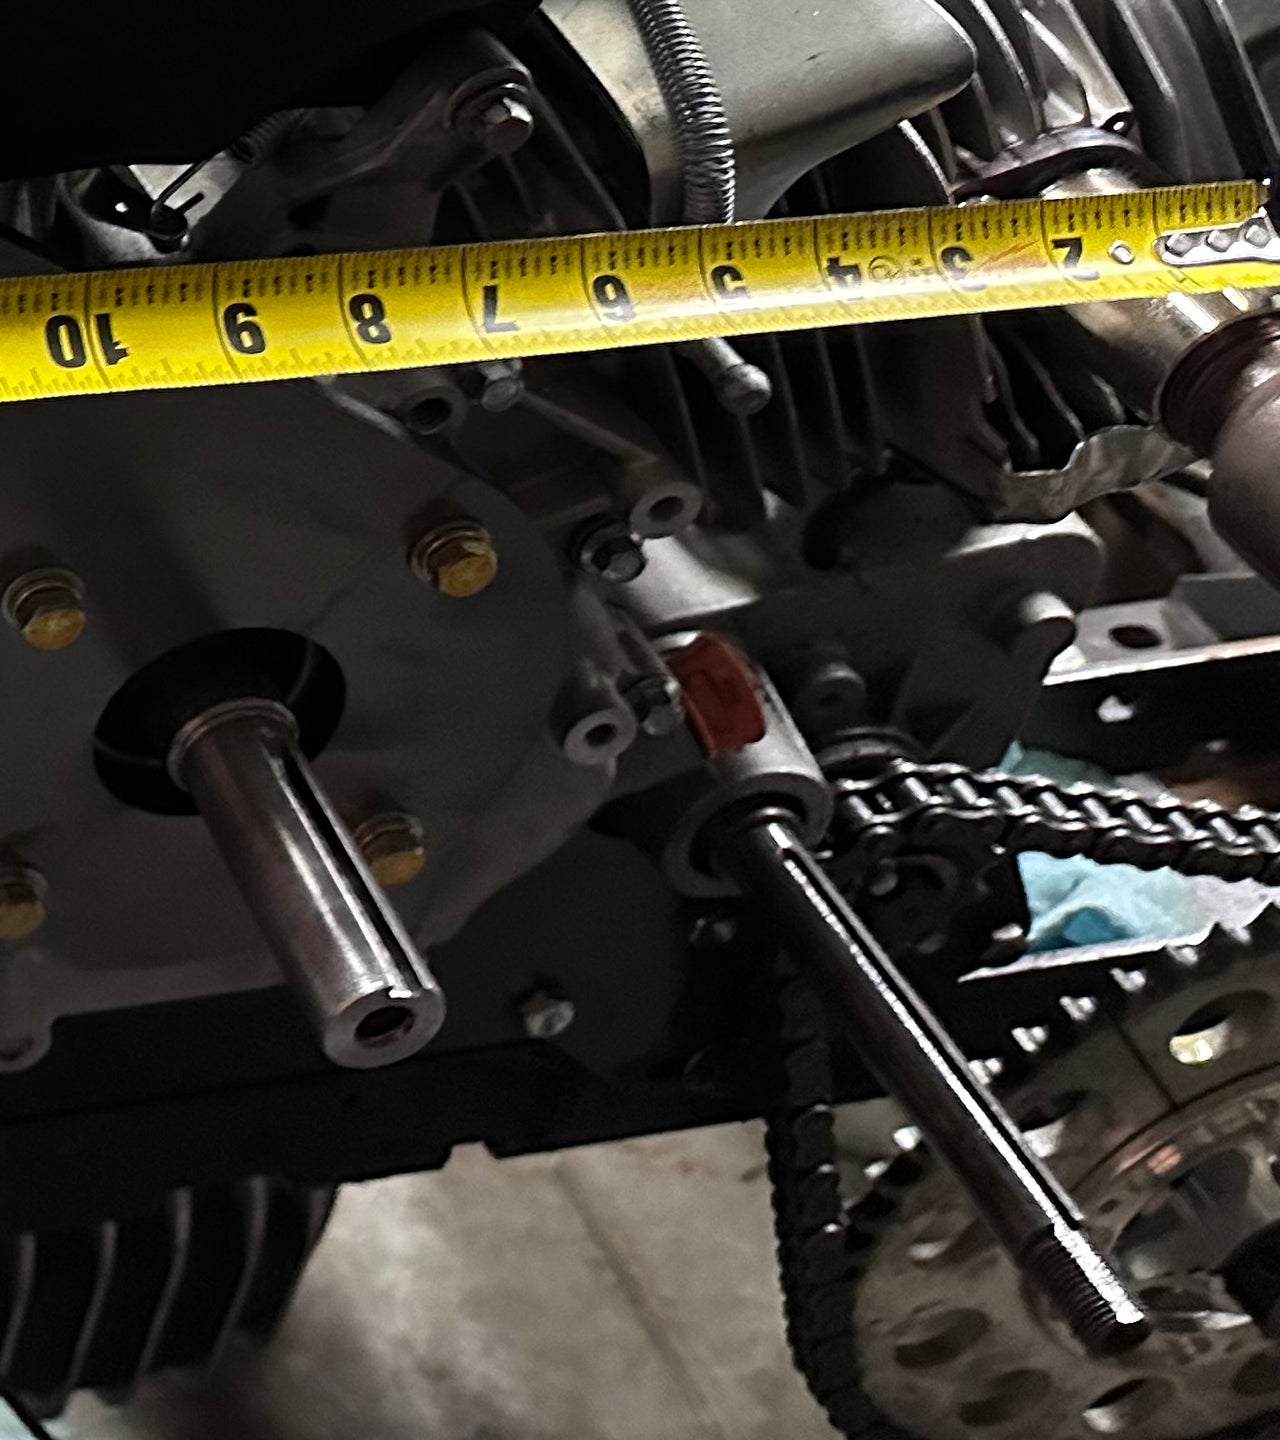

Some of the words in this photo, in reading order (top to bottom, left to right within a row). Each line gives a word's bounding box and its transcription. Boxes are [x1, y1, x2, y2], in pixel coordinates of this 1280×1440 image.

[593, 274, 636, 323] 6
[826, 256, 865, 301] 4
[223, 303, 266, 355] 9
[348, 293, 392, 345] 8
[482, 285, 518, 334] 7
[45, 313, 129, 369] 10
